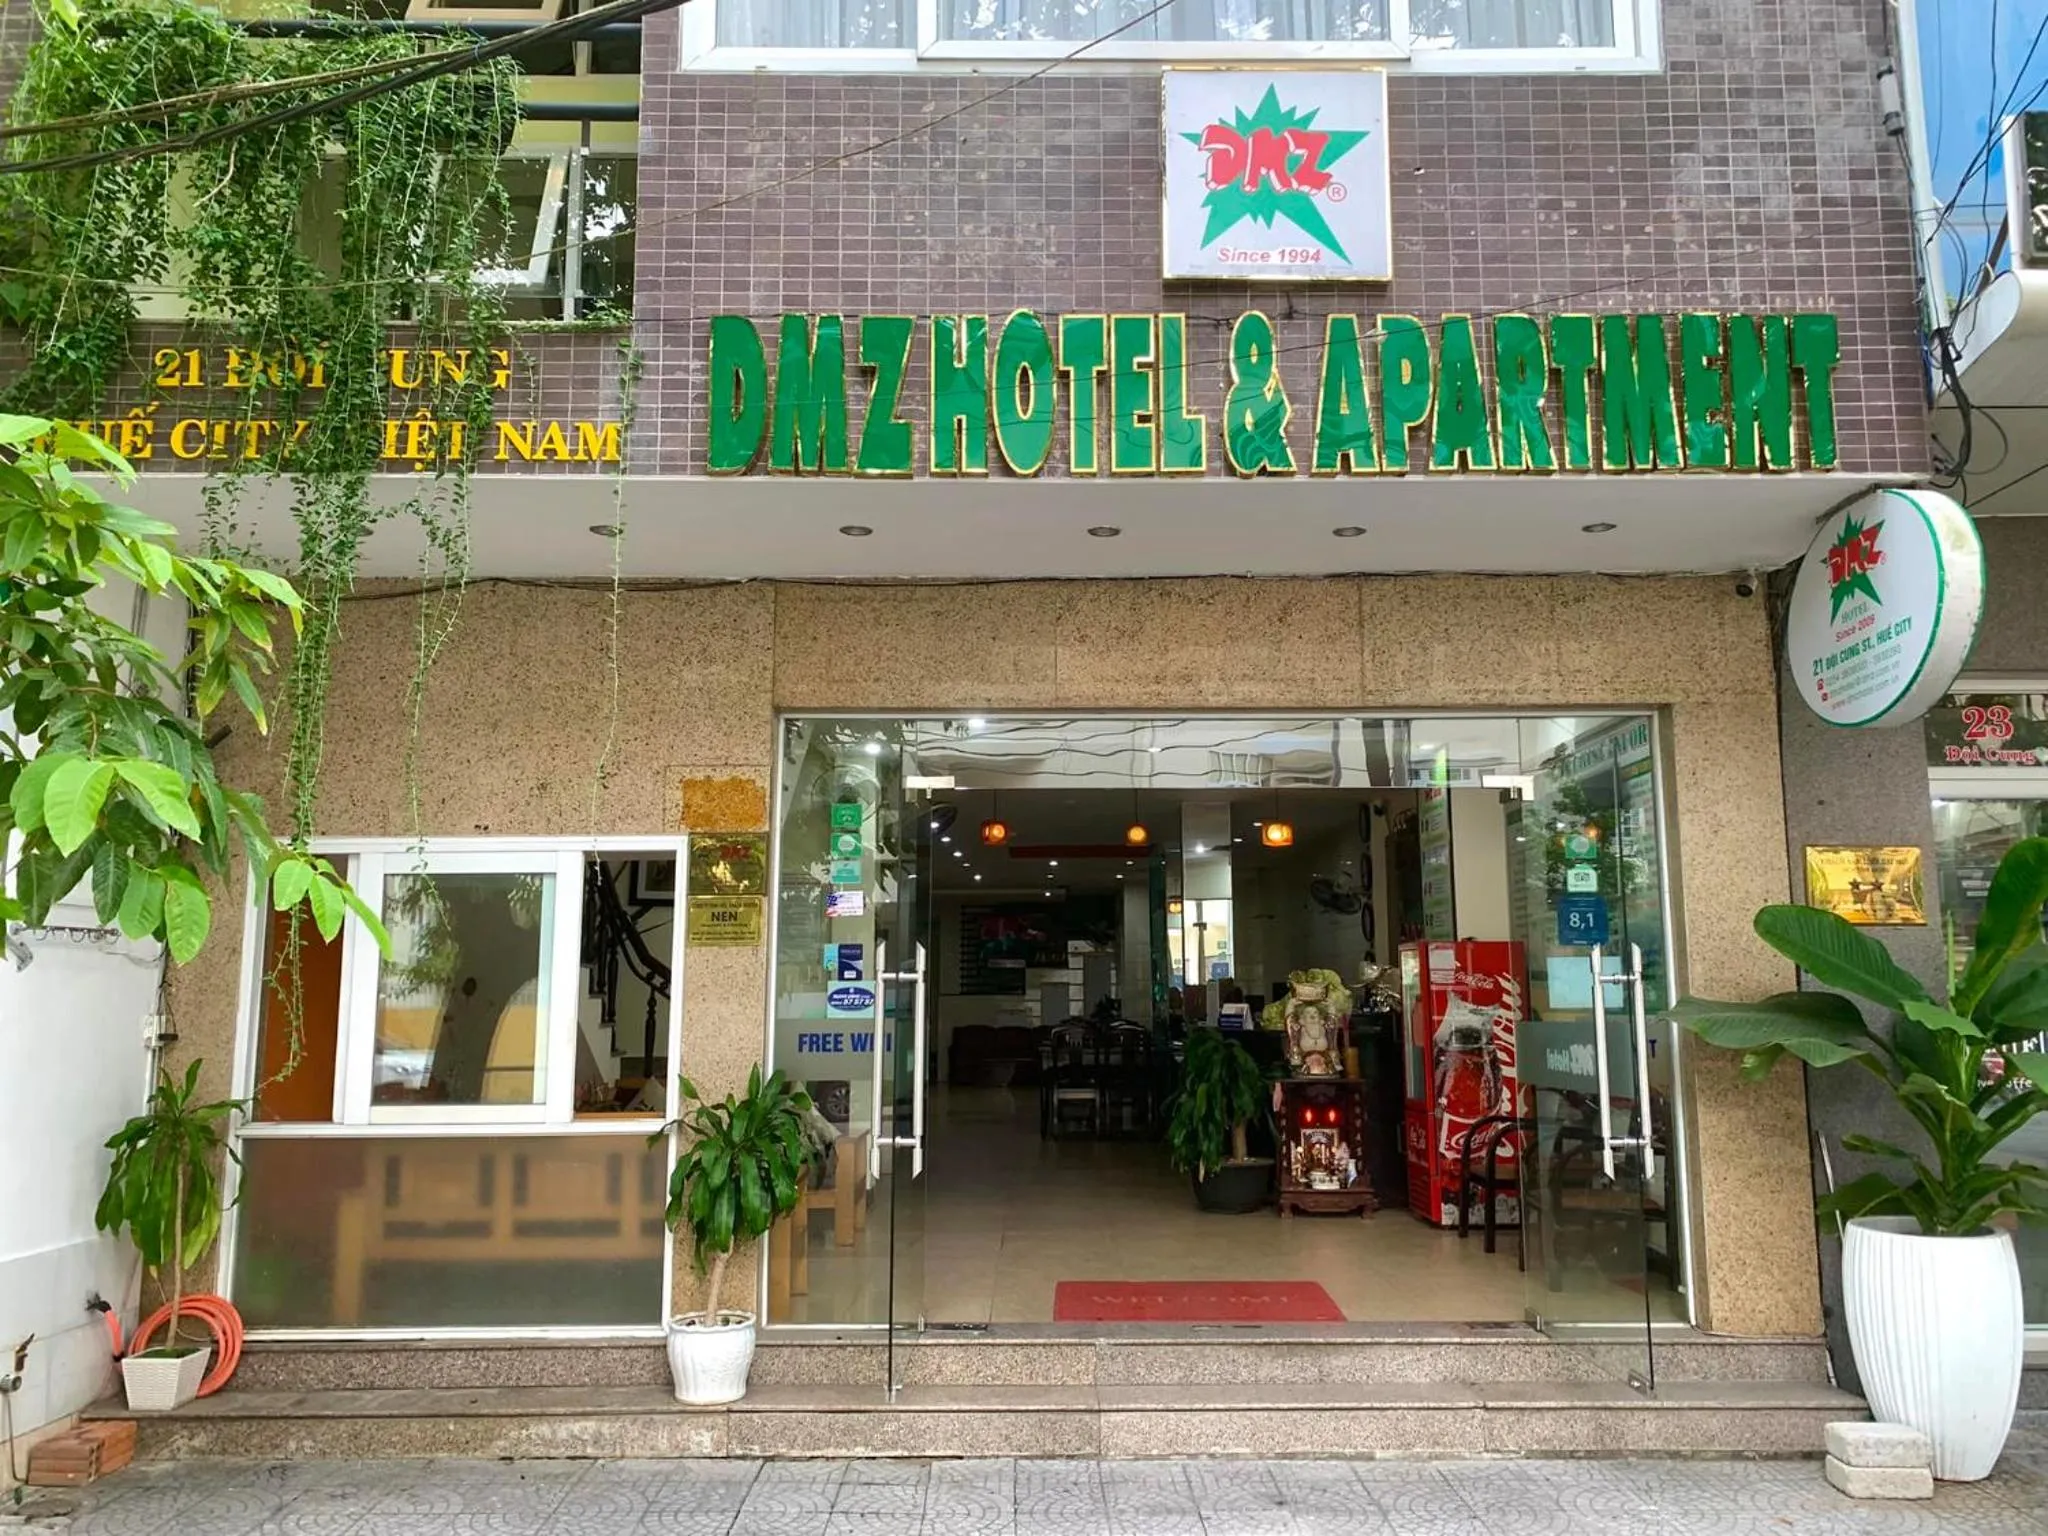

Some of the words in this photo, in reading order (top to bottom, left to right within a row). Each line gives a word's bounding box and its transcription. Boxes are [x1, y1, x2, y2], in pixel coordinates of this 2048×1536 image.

[1199, 124, 1333, 196] DMZ
[1218, 247, 1271, 263] Since
[1278, 248, 1322, 263] 1994
[154, 348, 204, 388] 21
[378, 349, 512, 389] UNG
[707, 313, 916, 475] DMZ
[930, 308, 1207, 475] HOTEL
[1224, 310, 1297, 477] &
[1311, 313, 1840, 472] APARTMENT
[379, 407, 468, 470] IỆT
[493, 420, 622, 461] NAM
[1812, 657, 1824, 677] 21
[1894, 615, 1912, 637] CITY
[1962, 705, 2014, 740] 23
[711, 911, 738, 922] NEN
[1569, 911, 1594, 930] 8,1
[797, 1032, 844, 1053] FREE
[850, 1032, 892, 1053] WII
